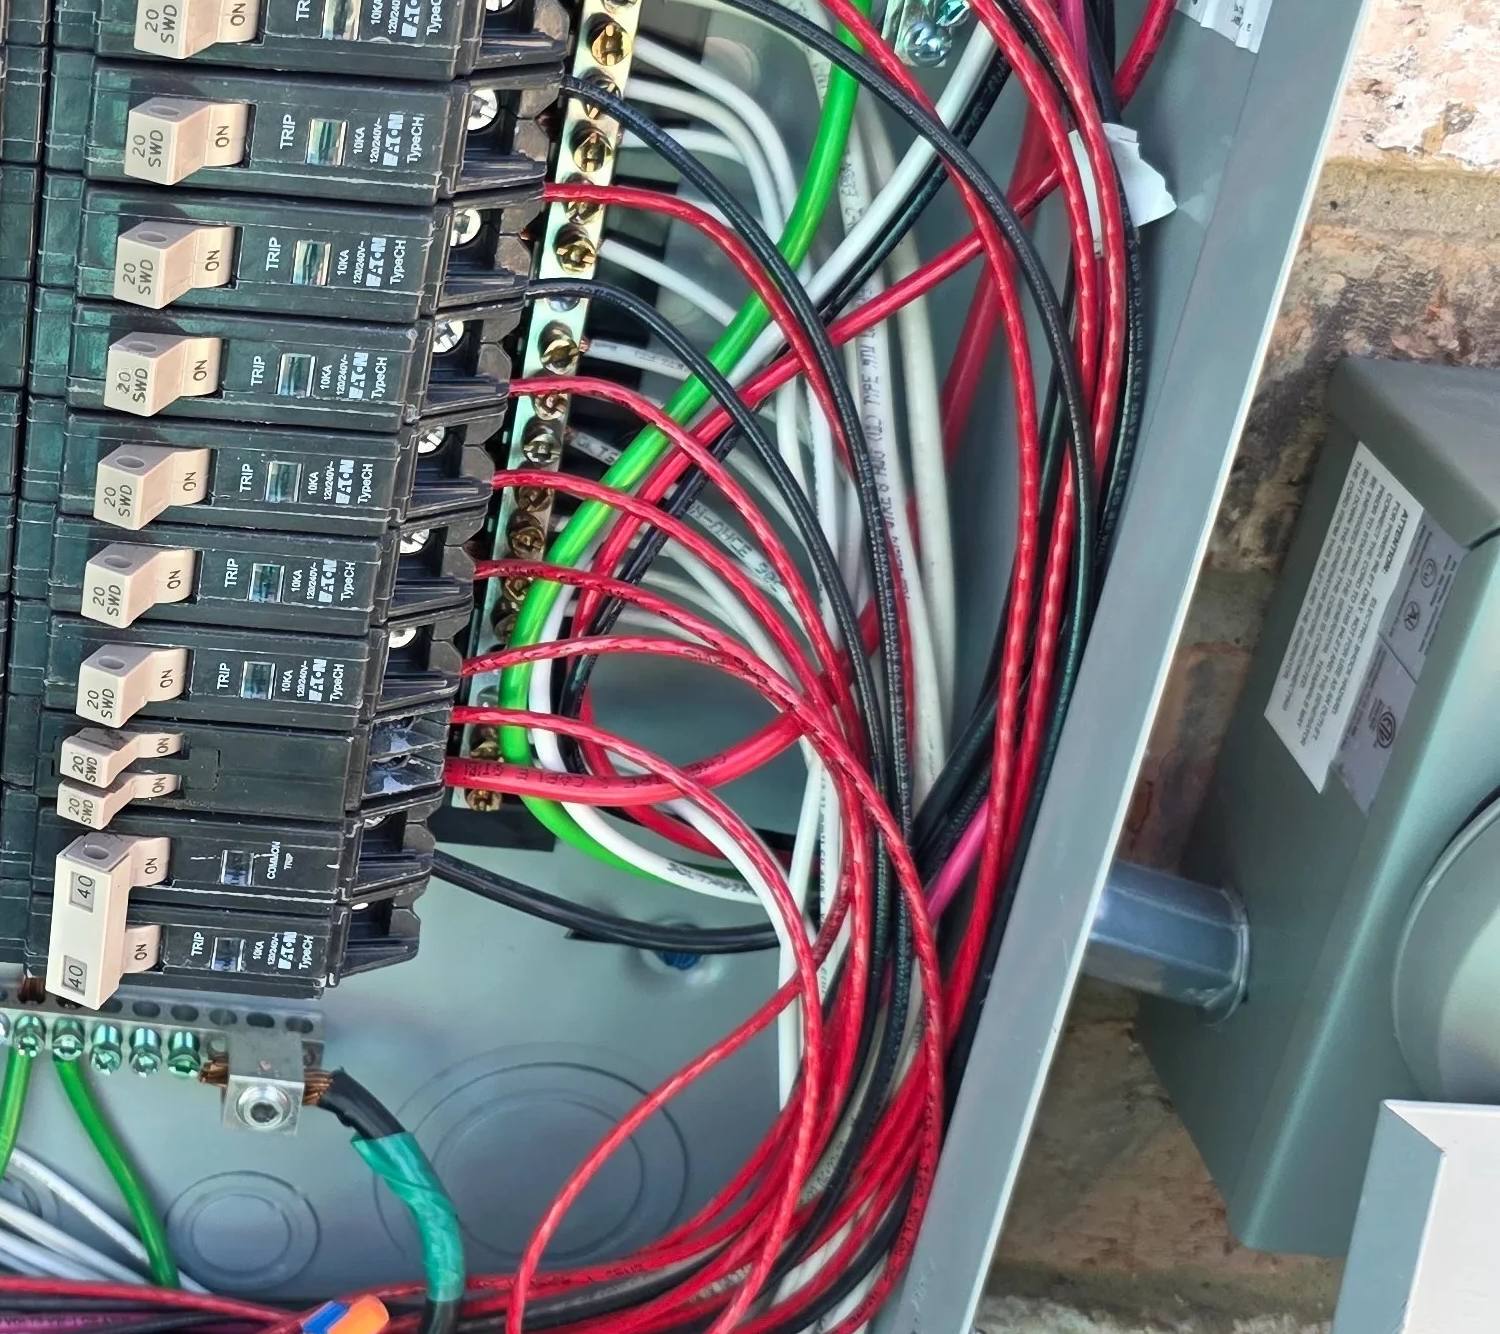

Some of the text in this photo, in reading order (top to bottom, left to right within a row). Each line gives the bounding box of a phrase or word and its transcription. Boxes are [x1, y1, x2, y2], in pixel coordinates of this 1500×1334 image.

[145, 9, 159, 33] 20
[161, 4, 177, 44] SWD
[231, 2, 246, 27] ON
[215, 124, 230, 149] ON
[280, 114, 295, 149] TRIP
[132, 134, 146, 158] 20
[148, 130, 164, 168] SWD
[205, 249, 220, 271] ON
[266, 237, 282, 271] TRIP
[123, 262, 136, 285] 20
[138, 259, 153, 296] SWD
[193, 359, 207, 381] ON
[250, 355, 266, 387] TRIP
[183, 471, 197, 492] ON
[239, 463, 254, 493] TRIP
[103, 486, 116, 508] 20
[118, 484, 133, 518] SWD
[167, 569, 181, 590] ON
[92, 586, 105, 607] 20
[107, 584, 122, 617] SWD
[160, 669, 173, 689] ON
[87, 689, 99, 710] 20
[101, 688, 115, 719] SWD
[144, 856, 157, 874] ON
[77, 875, 94, 899] 40
[191, 931, 204, 956] TRIP
[67, 964, 84, 988] 40
